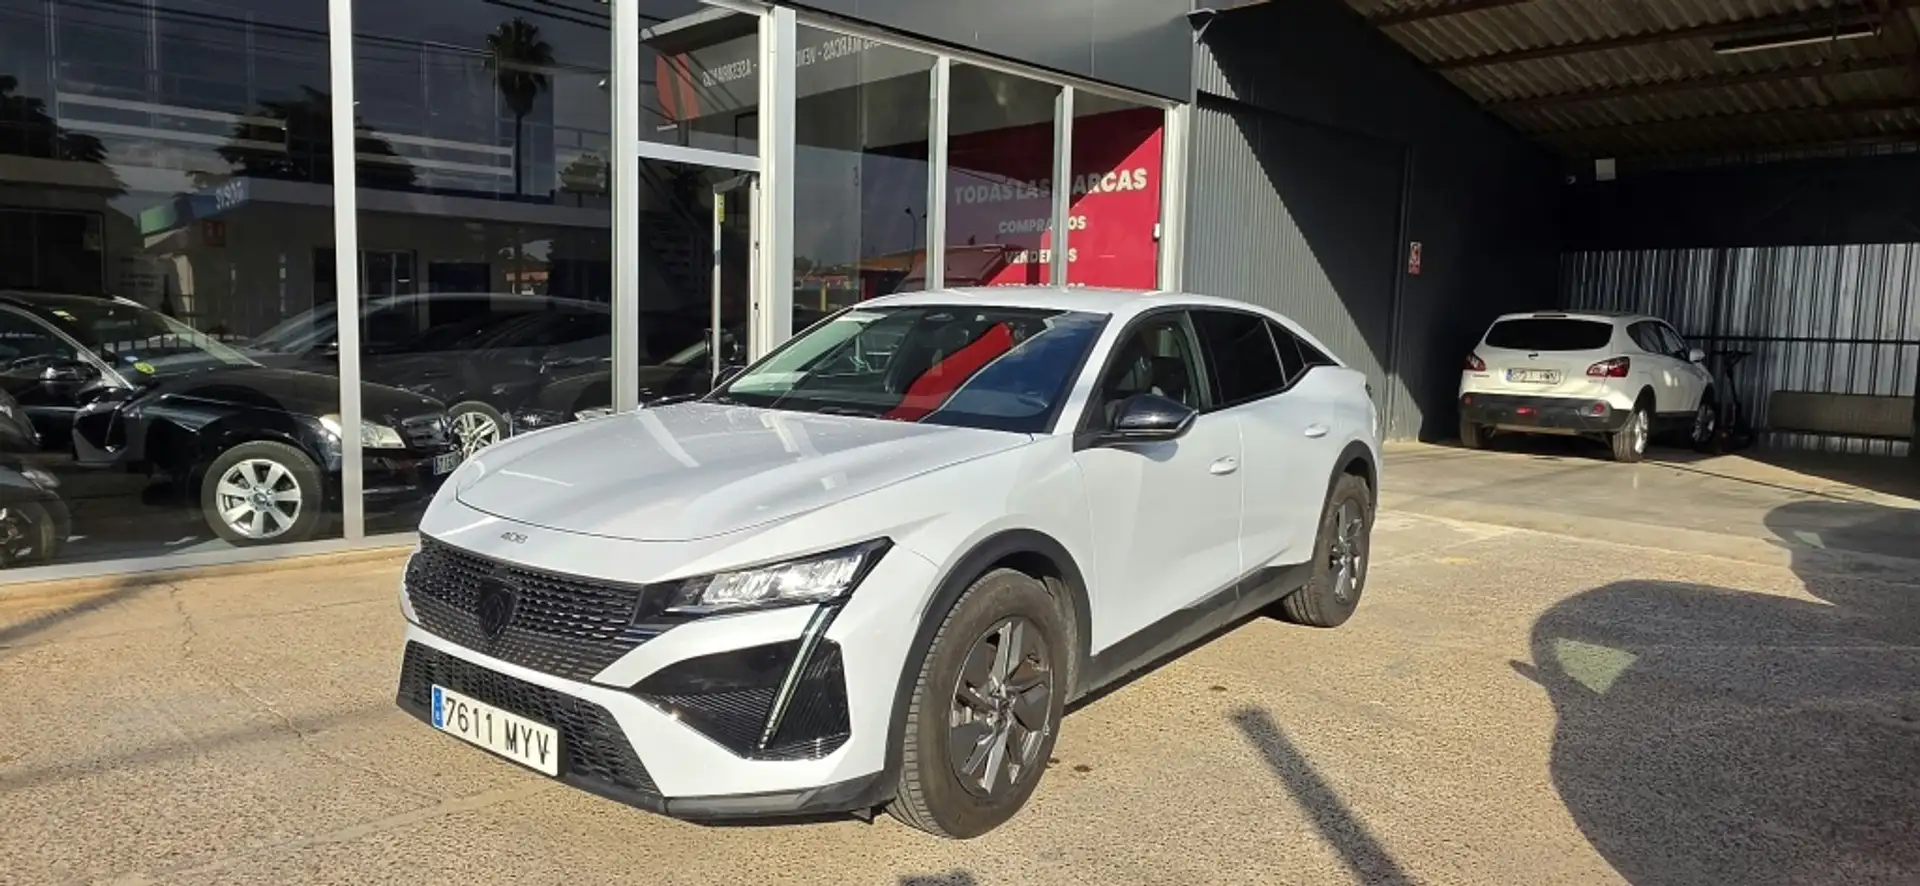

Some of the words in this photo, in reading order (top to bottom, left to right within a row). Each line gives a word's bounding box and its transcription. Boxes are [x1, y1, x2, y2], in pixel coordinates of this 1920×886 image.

[954, 183, 1011, 205] TODAS
[1016, 177, 1050, 200] LAS
[1073, 168, 1147, 194] ARCAS
[998, 215, 1087, 233] COMPRAOS
[1005, 248, 1077, 264] VENDES
[500, 532, 528, 544] 408
[446, 697, 492, 744] 7611
[505, 719, 549, 765] MYV
